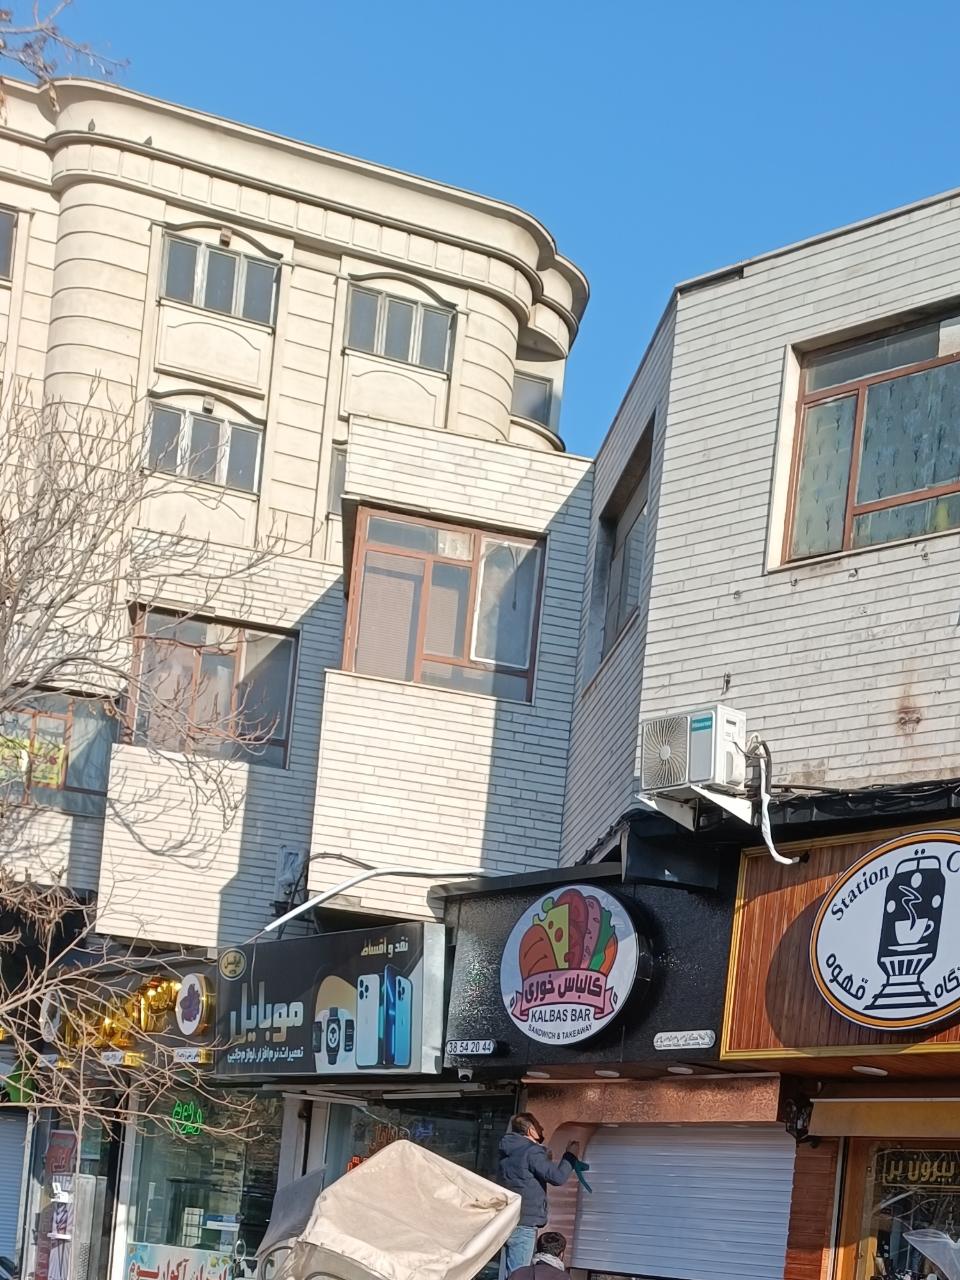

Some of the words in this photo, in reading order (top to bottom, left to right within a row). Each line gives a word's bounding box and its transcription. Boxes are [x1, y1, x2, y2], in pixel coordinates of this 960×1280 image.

[831, 865, 890, 921] Station
[394, 935, 409, 952] نقد
[524, 973, 556, 1004] خوری
[557, 973, 604, 999] کالباس
[825, 953, 869, 1001] قهوه
[229, 981, 304, 1044] موبایل
[530, 1008, 569, 1024] KALBAS
[571, 1007, 592, 1022] BAR
[527, 1024, 556, 1040] SANDWICH
[561, 1024, 593, 1040] TAKEAWAY
[448, 1041, 458, 1053] 38
[459, 1041, 469, 1053] 54
[470, 1041, 481, 1053] 20
[482, 1040, 492, 1053] 44
[886, 1160, 904, 1180] بر
[907, 1154, 955, 1182] بیرون
